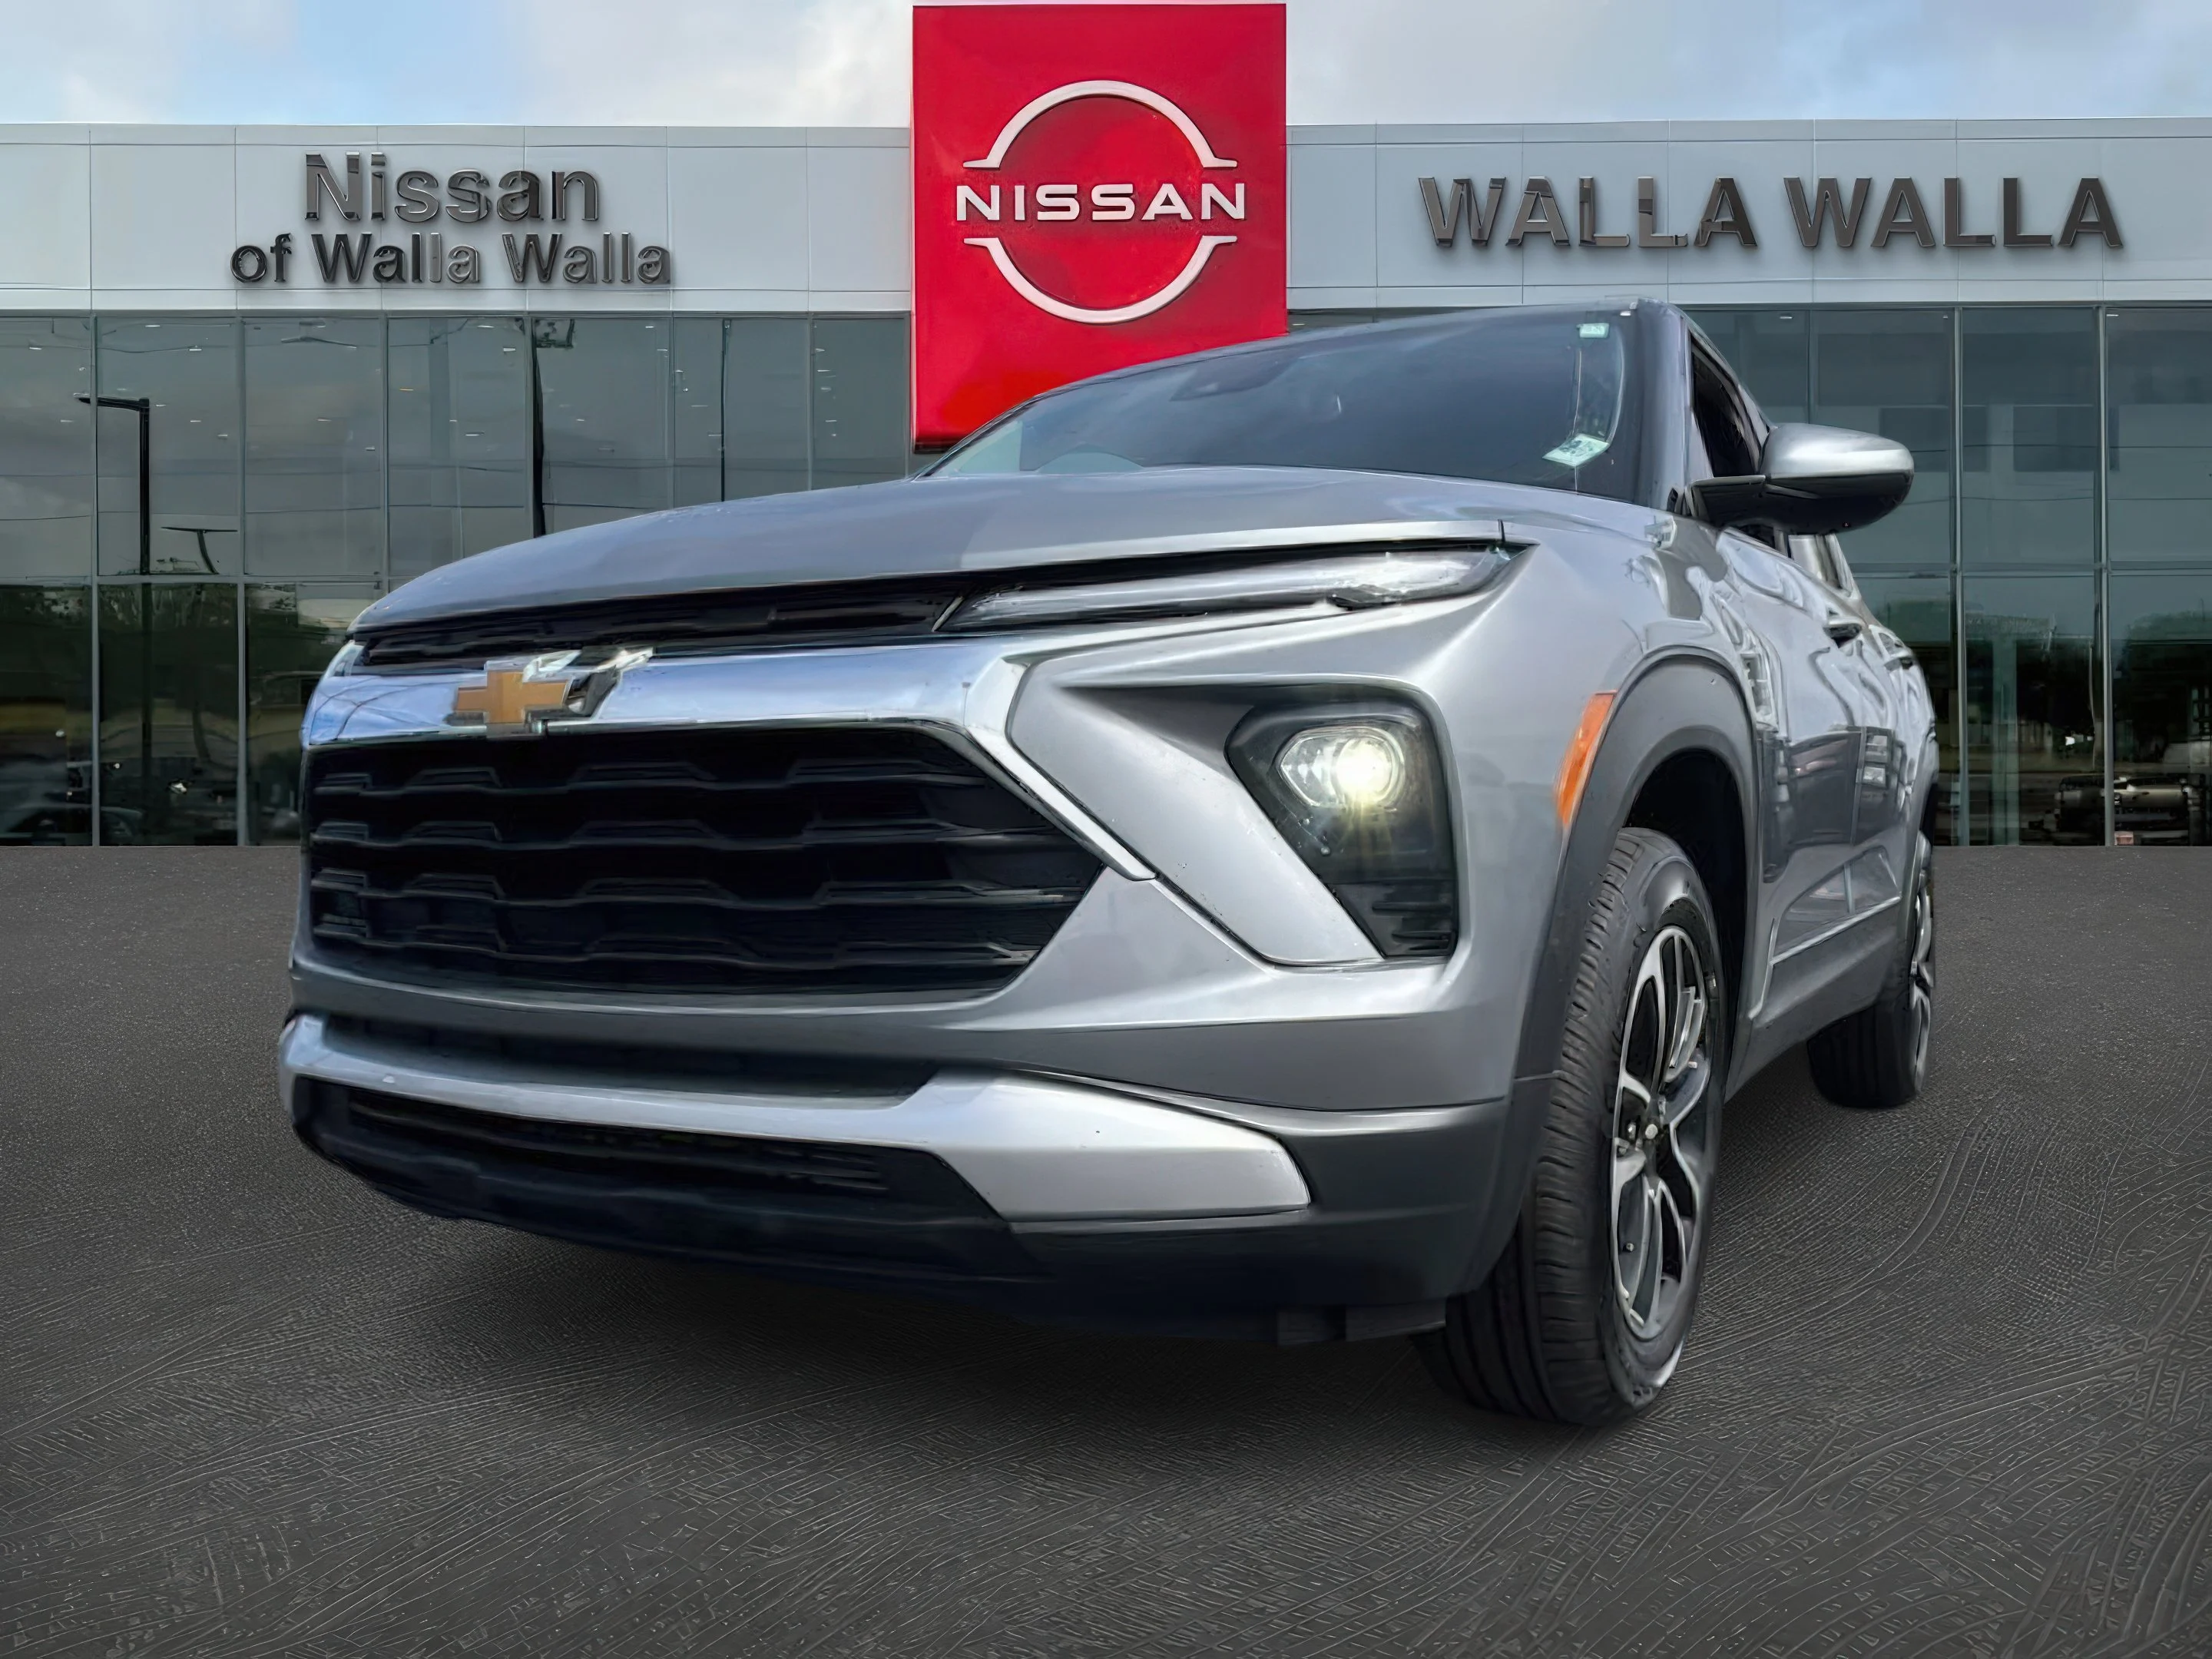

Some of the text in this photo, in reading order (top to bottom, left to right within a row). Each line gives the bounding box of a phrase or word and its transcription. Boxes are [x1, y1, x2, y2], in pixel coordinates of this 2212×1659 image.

[305, 151, 600, 223] Nissan
[955, 182, 1246, 221] NISSAN
[1418, 176, 2124, 250] WALLA WALLA
[230, 232, 671, 284] of Walla Walla
